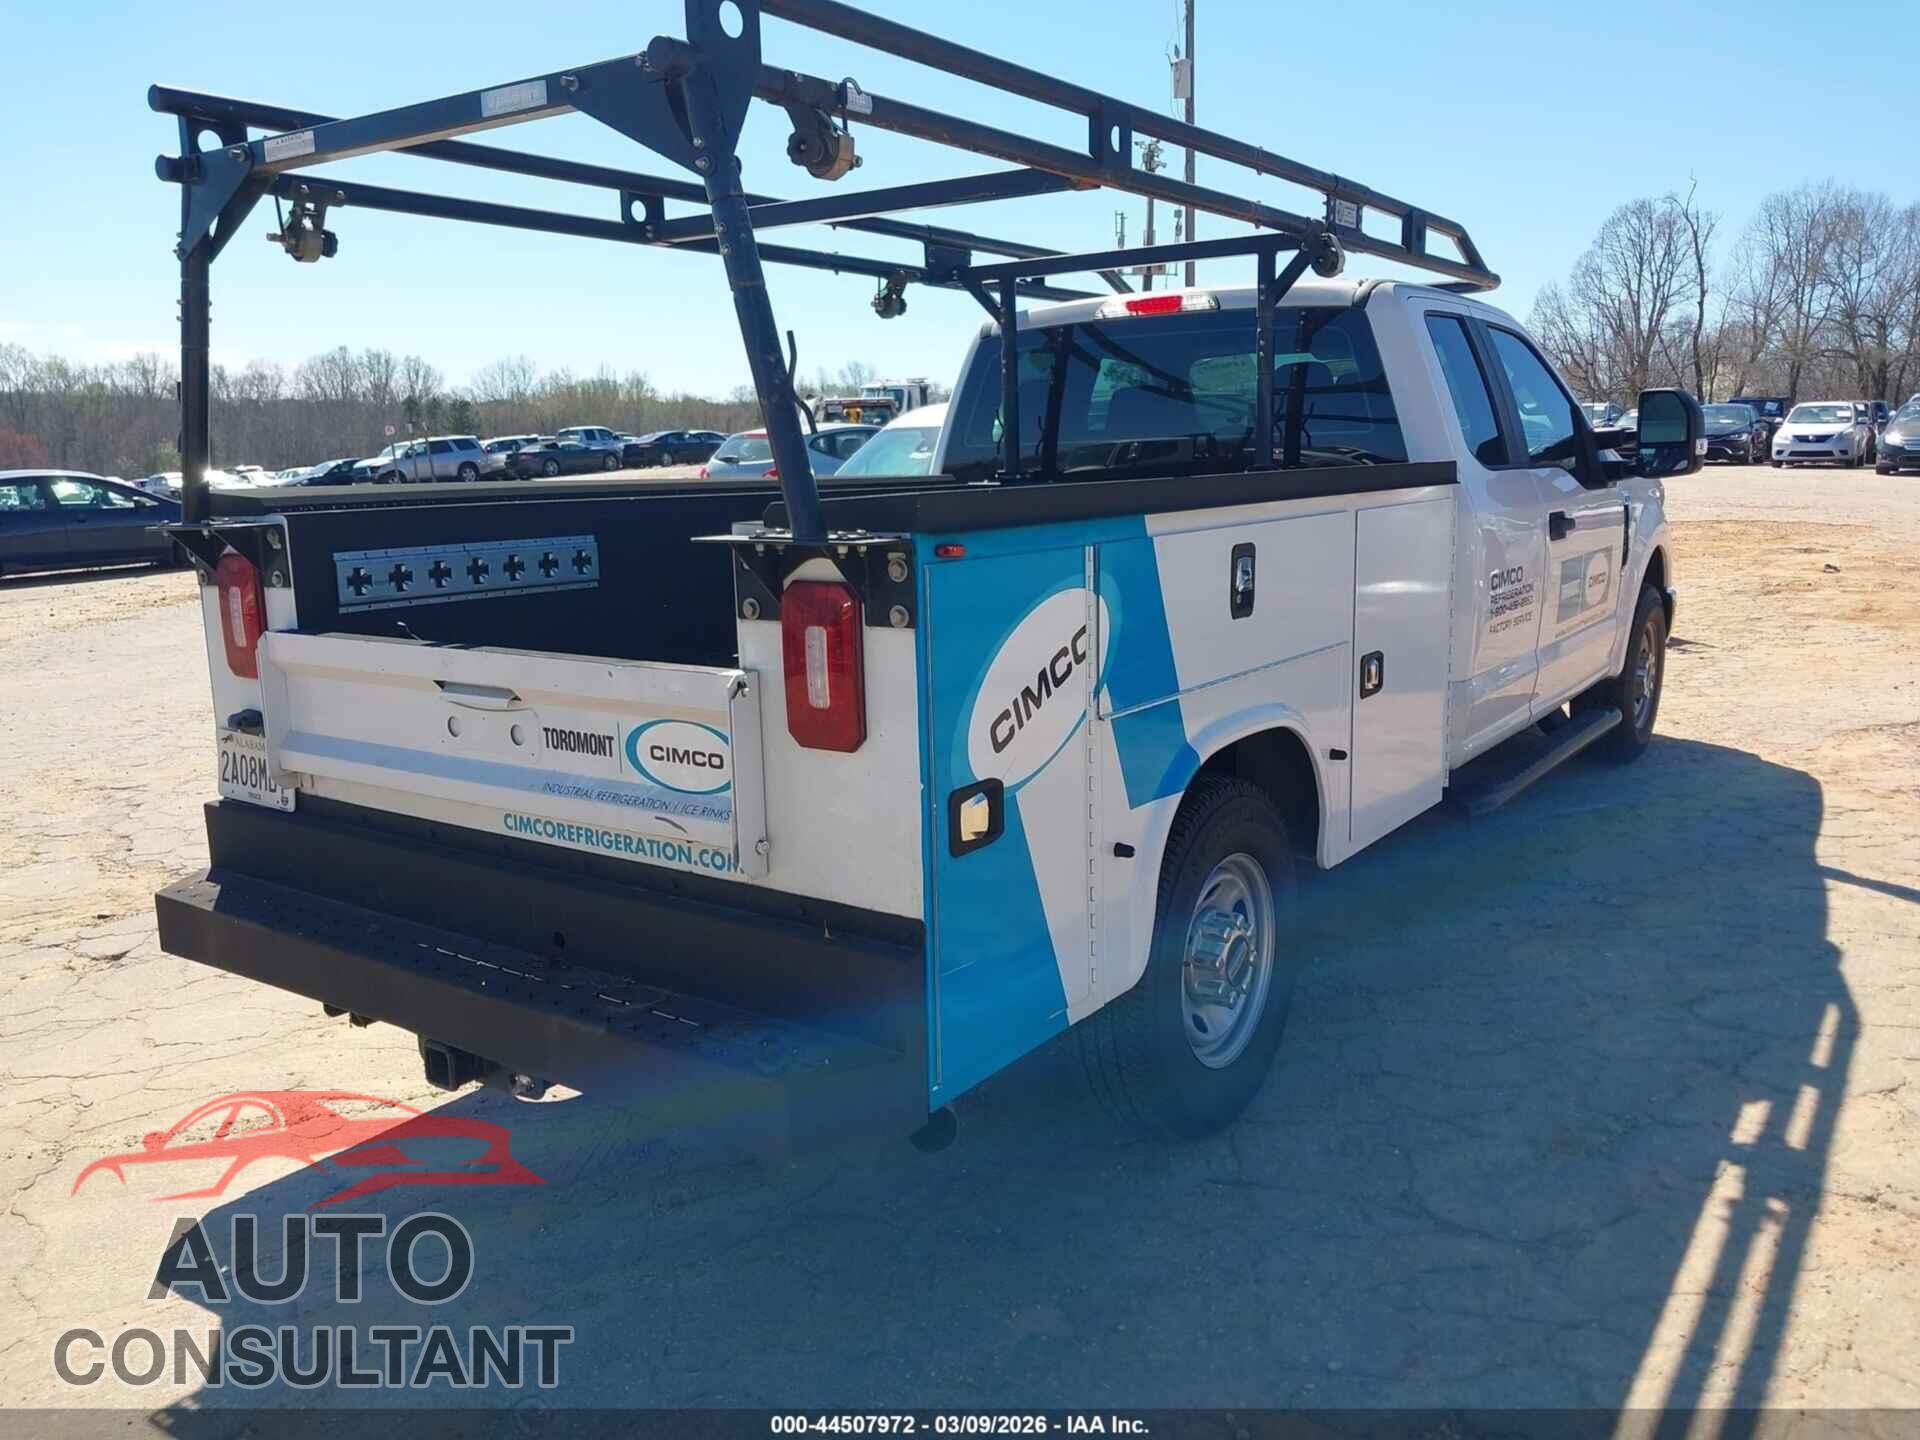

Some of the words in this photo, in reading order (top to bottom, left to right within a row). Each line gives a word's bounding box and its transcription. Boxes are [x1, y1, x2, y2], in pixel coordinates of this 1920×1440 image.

[1491, 566, 1523, 590] CIMCO
[543, 727, 615, 758] TOROMONT
[650, 745, 725, 770] CIMCO
[543, 782, 593, 800] INDUSTRIAL
[594, 790, 671, 811] REFRIGERATION
[702, 806, 732, 821] RINKS
